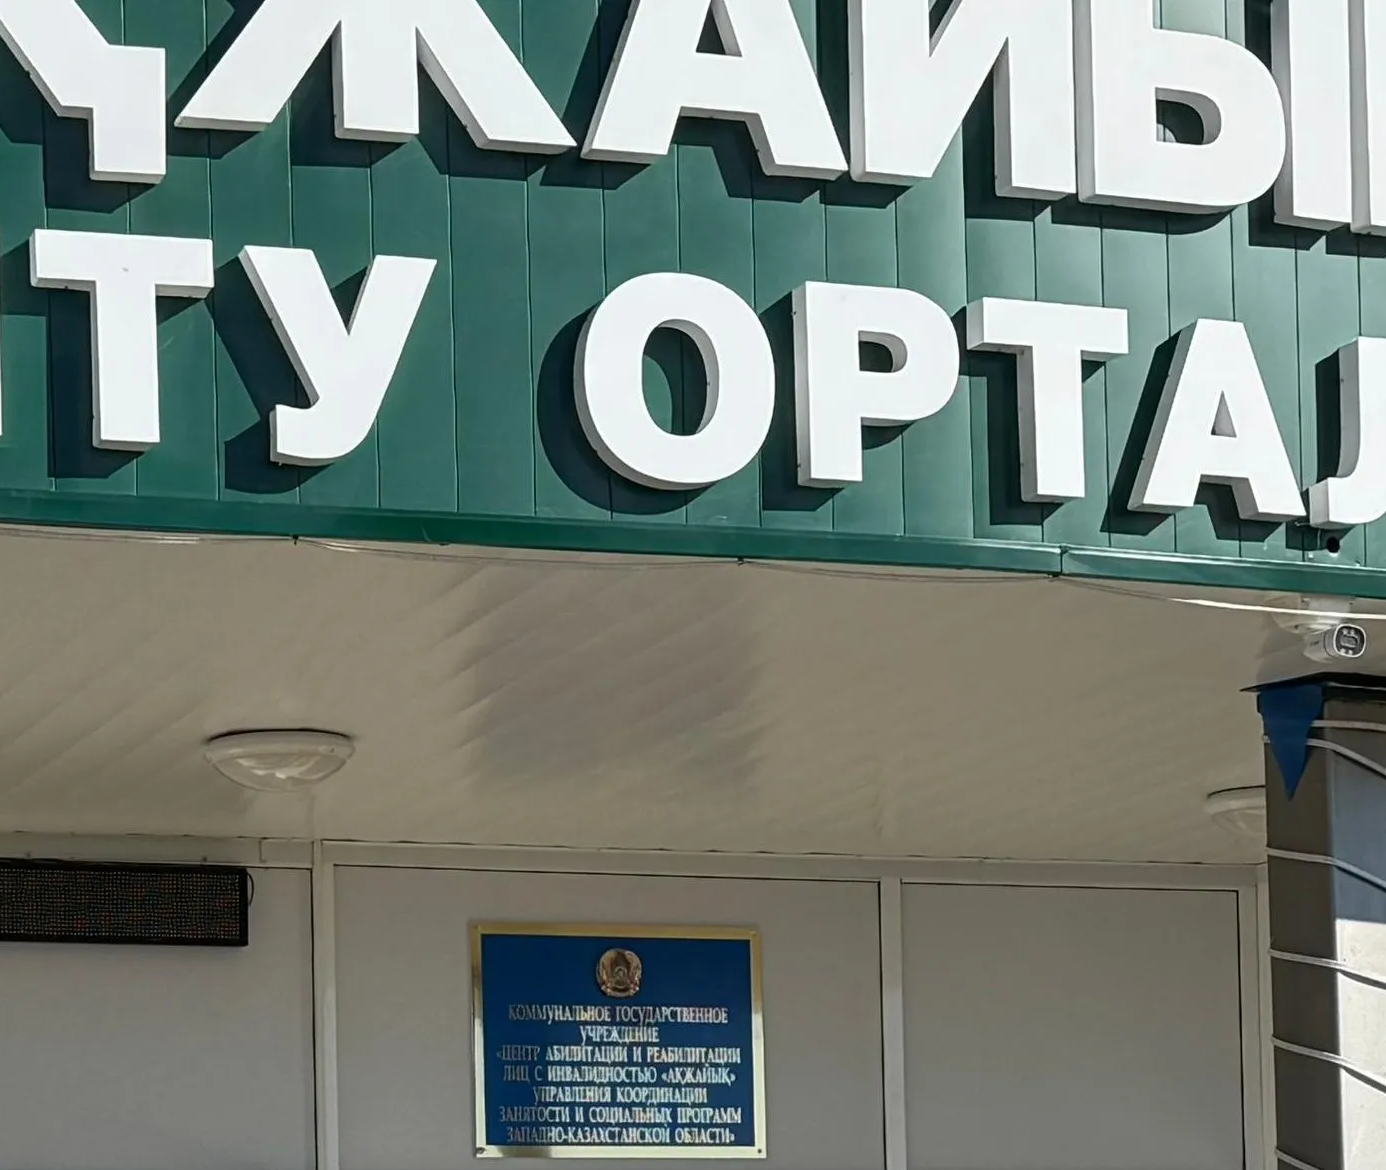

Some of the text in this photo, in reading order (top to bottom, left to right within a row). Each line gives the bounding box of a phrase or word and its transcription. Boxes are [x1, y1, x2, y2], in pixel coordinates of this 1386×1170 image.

[508, 1005, 728, 1025] КОММУНАЛЬНОЕ ГОСУДАРСТВЕННОЕ
[580, 1026, 659, 1044] УЧРЕЖДЕНИЕ
[546, 1047, 628, 1063] АБИЛИТАЦИИ
[634, 1049, 642, 1062] И
[647, 1048, 741, 1065] РЕАБИЛИТАЦИИ
[534, 1067, 542, 1081] С
[548, 1066, 656, 1083] ИНВАЛИДНОСТЬЮ
[534, 1087, 707, 1105] УПРАВЛЕНИЯ КООРДИНАЦИИ
[500, 1107, 741, 1124] ЗАНЯТОСТИ И СОЦИАЛЬНЫХ ПРОГРАММ
